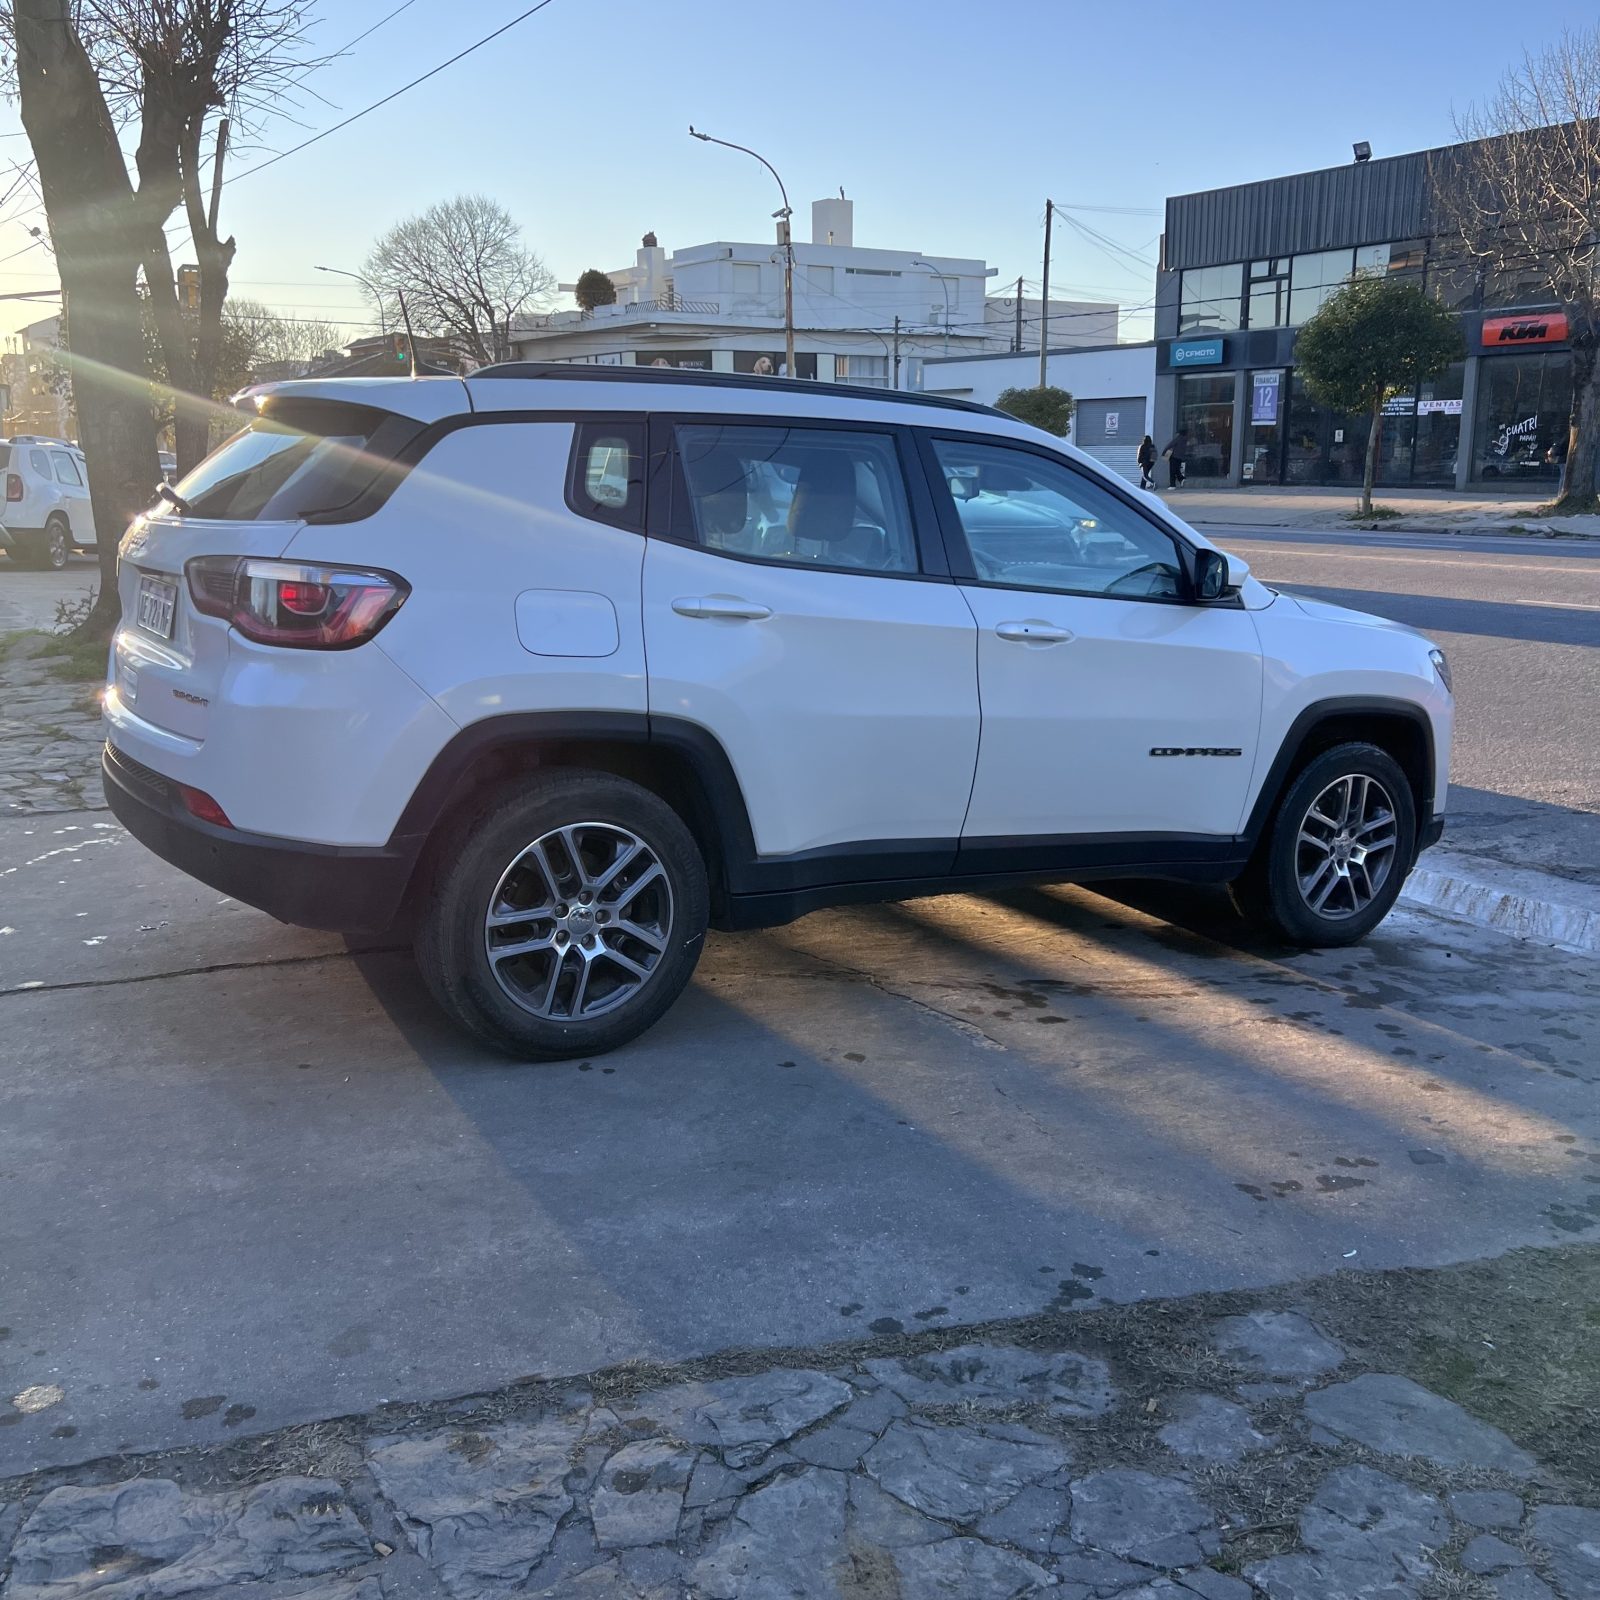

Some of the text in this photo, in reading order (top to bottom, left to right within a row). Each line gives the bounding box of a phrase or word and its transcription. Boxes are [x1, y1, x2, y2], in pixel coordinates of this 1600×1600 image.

[1498, 320, 1549, 341] KTM
[1185, 348, 1216, 357] CFMOTO
[1259, 387, 1273, 407] 12
[1423, 400, 1461, 408] VENTAS
[1506, 415, 1537, 436] CUATRI
[1149, 747, 1242, 757] COMPASS
